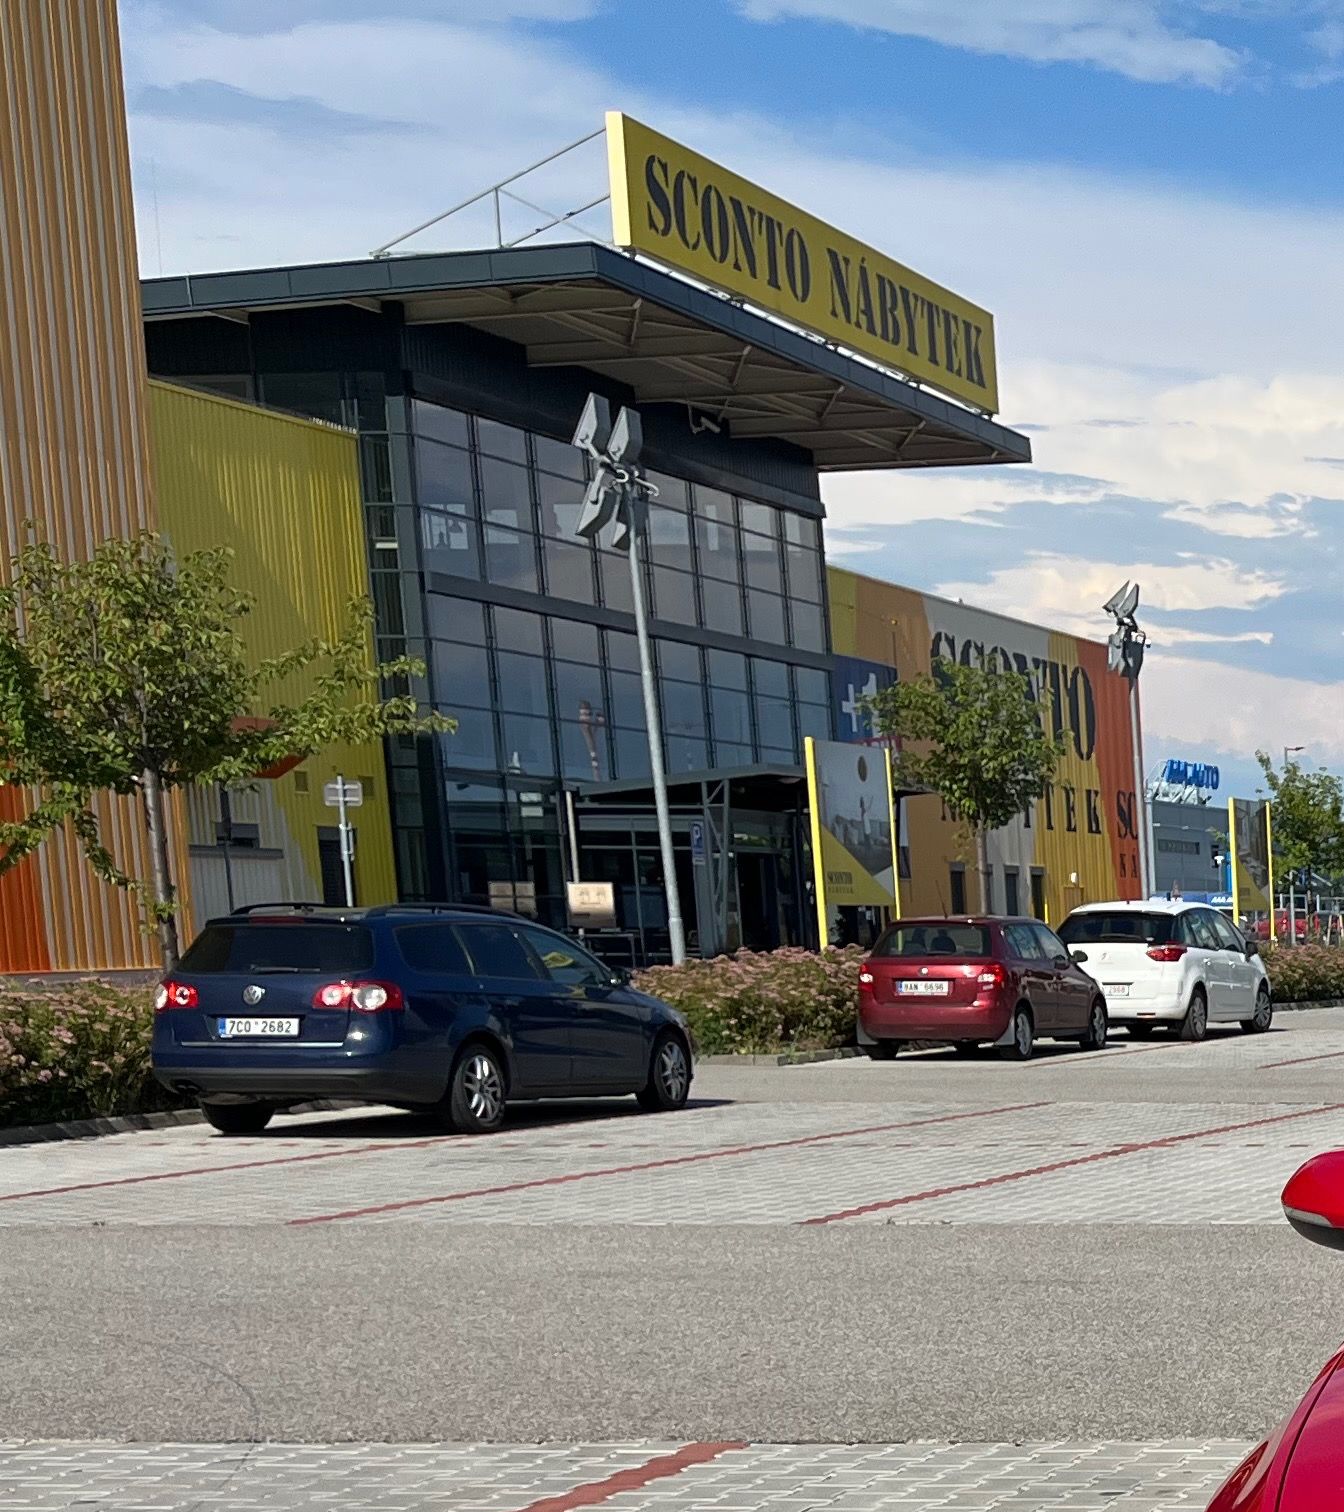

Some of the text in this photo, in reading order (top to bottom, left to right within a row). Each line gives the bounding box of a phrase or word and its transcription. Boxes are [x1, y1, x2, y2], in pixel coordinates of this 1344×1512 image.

[645, 155, 987, 389] SCONTO NÁBYTEK
[261, 1020, 292, 1033] 2682
